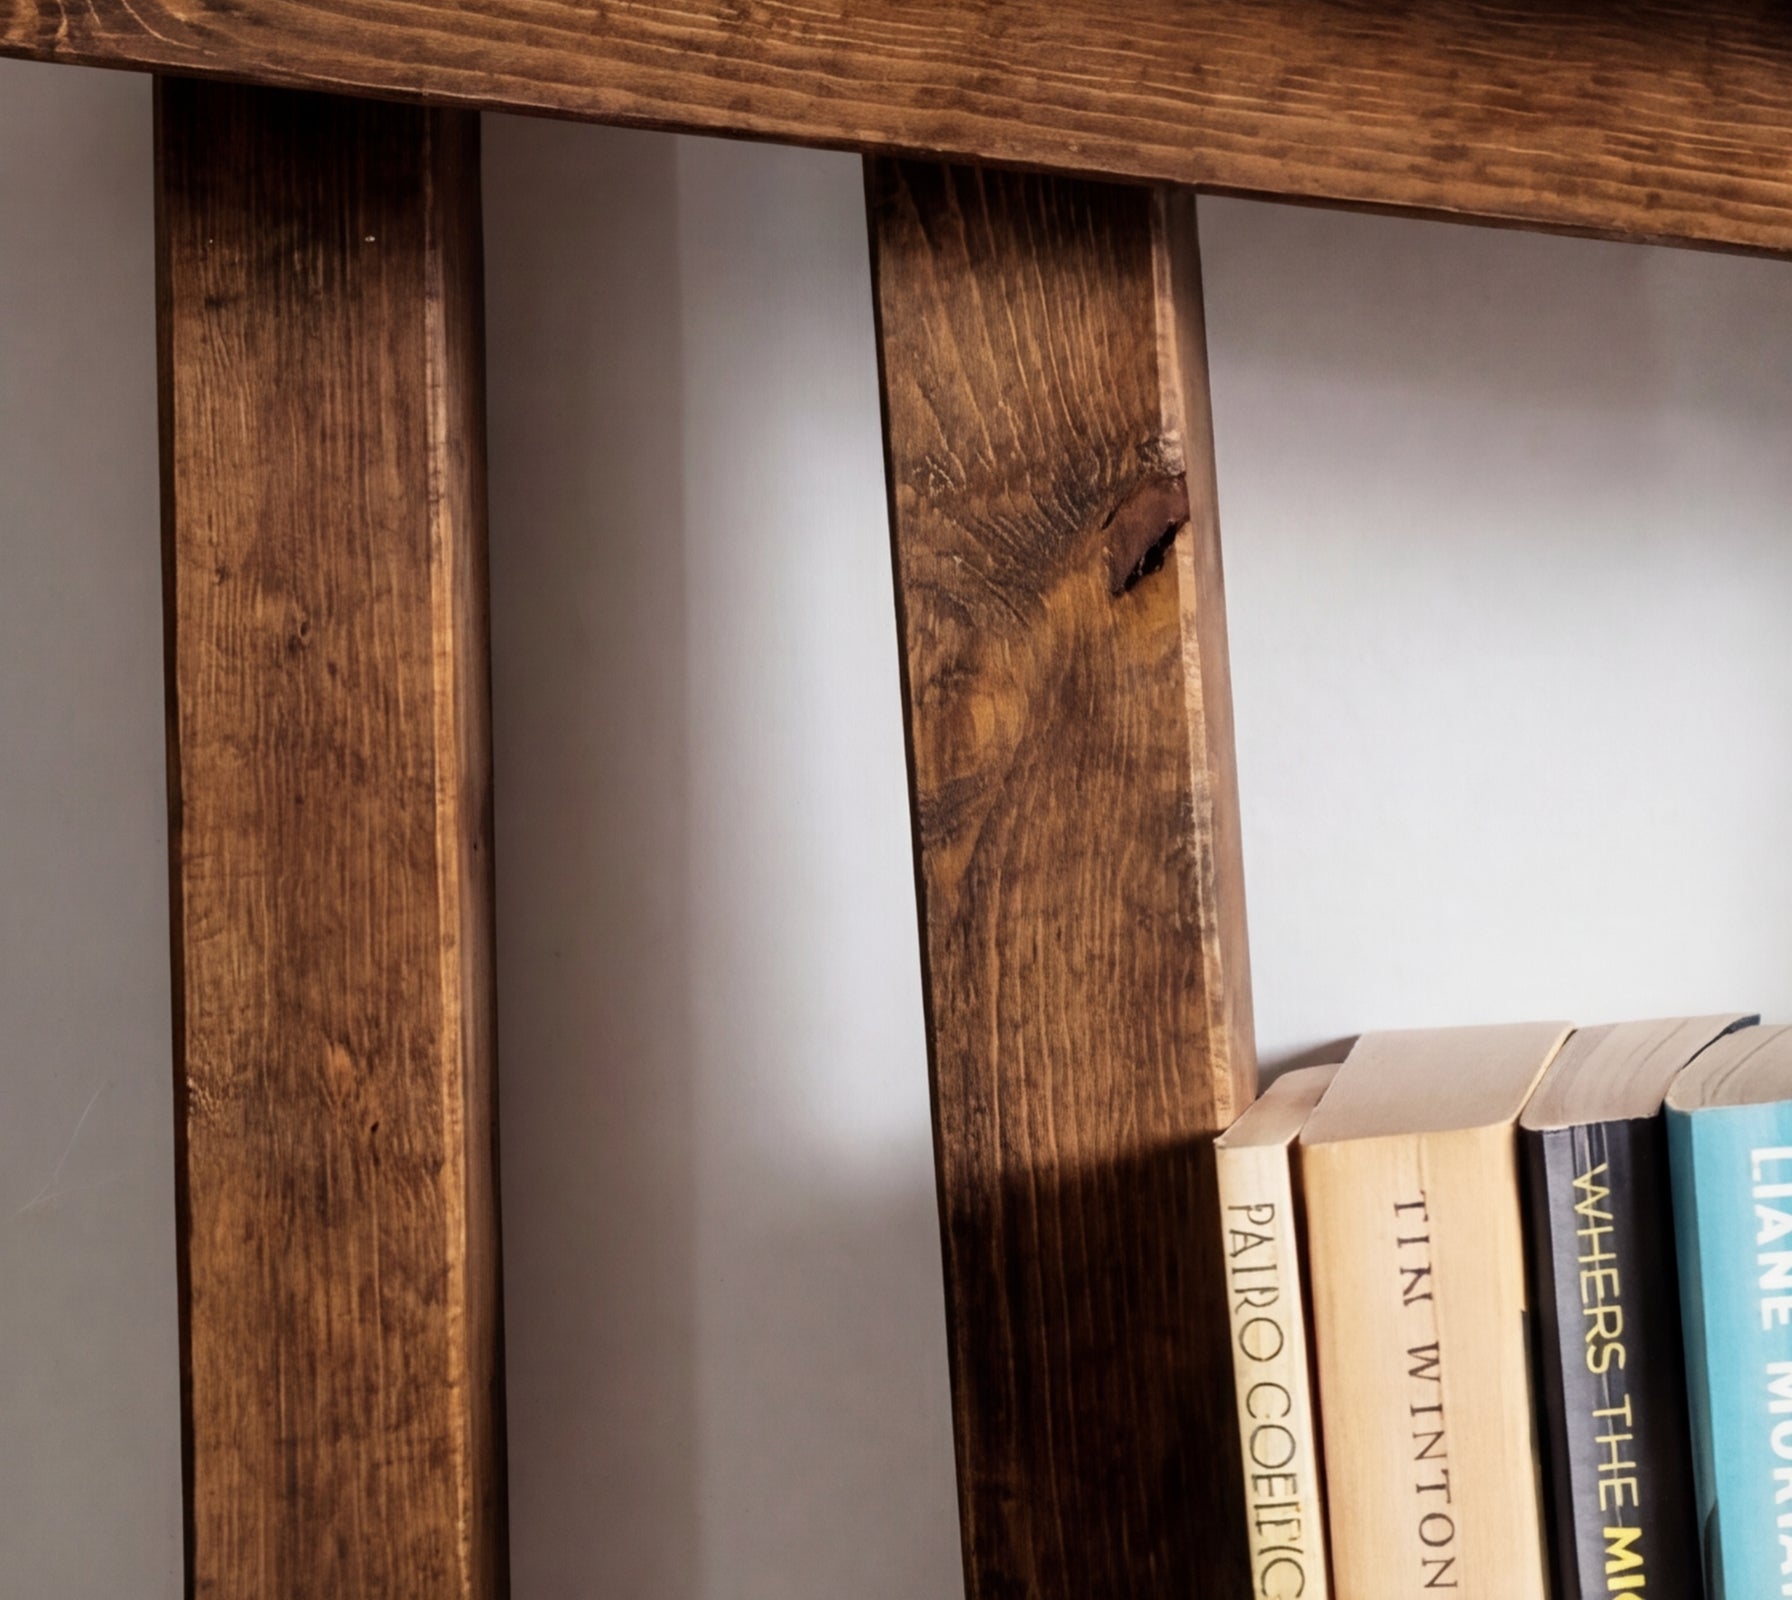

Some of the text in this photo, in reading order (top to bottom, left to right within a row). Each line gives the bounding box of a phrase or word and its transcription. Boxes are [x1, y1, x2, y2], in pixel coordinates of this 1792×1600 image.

[1572, 1163, 1627, 1375] WHERS
[1406, 1343, 1459, 1591] WINTON
[1592, 1394, 1640, 1512] THE
